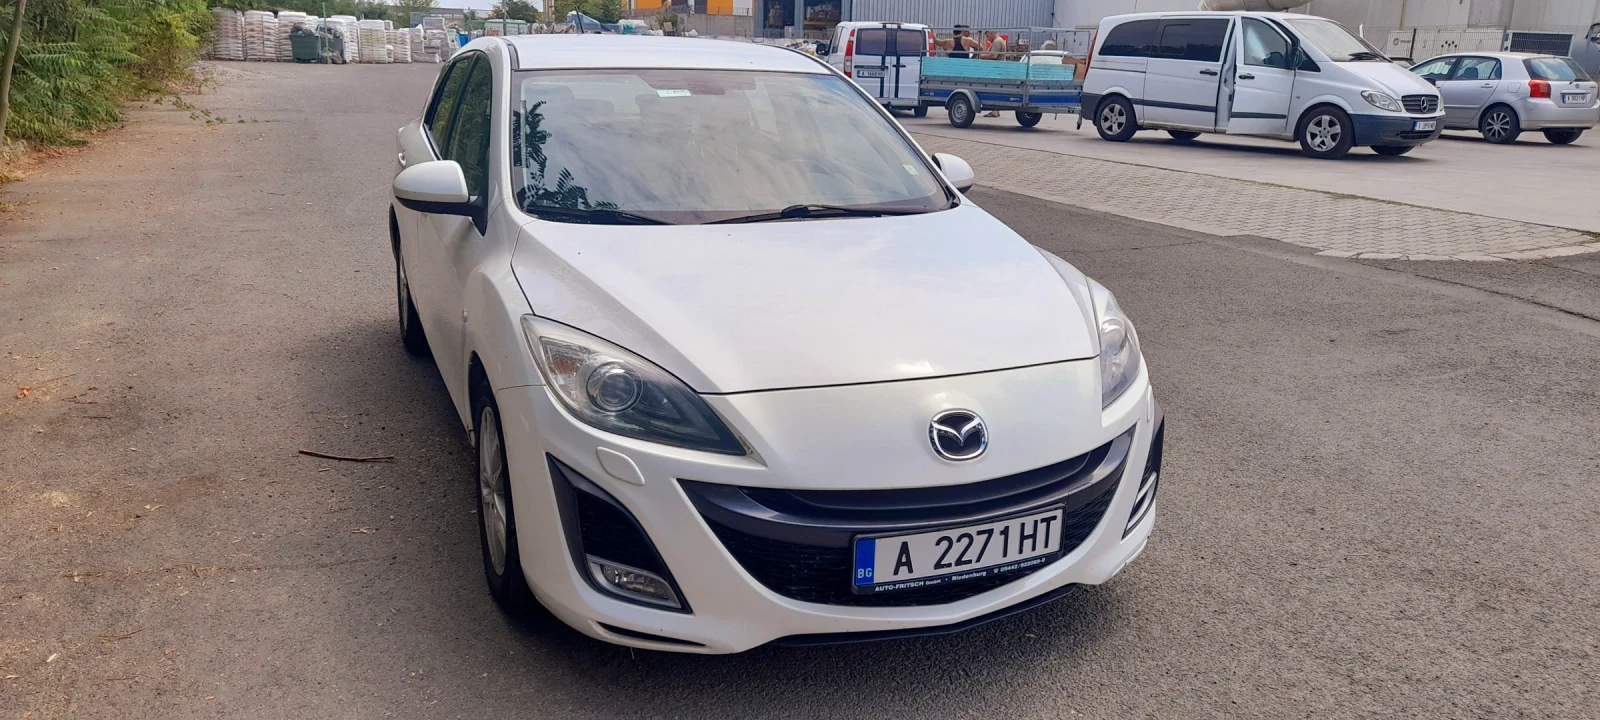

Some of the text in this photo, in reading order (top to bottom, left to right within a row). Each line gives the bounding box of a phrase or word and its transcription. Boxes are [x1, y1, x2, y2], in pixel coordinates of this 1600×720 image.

[893, 541, 914, 576] A
[857, 567, 873, 579] BG
[875, 580, 924, 592] AUTO-FRITSCH
[951, 571, 987, 582] Riedenburg
